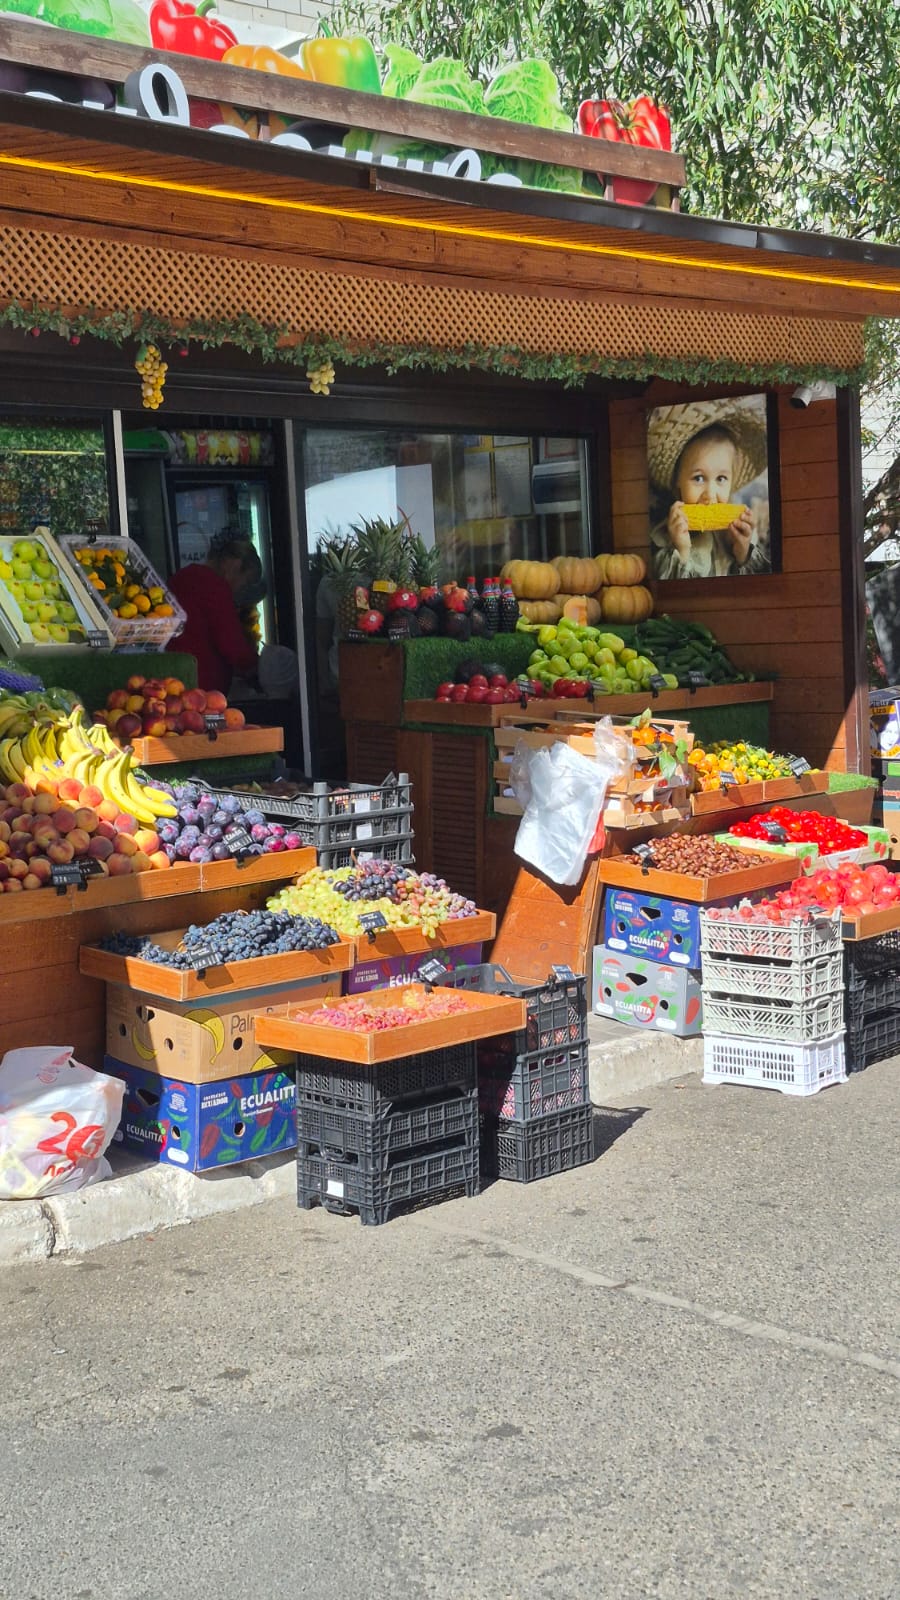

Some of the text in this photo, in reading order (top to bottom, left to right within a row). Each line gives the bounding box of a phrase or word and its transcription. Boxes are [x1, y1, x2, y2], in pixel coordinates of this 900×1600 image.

[628, 934, 665, 949] ECUALITTA
[615, 1000, 652, 1014] ECUALITTA
[240, 1084, 297, 1111] ECUALITT
[126, 1124, 163, 1144] ECUALITTA
